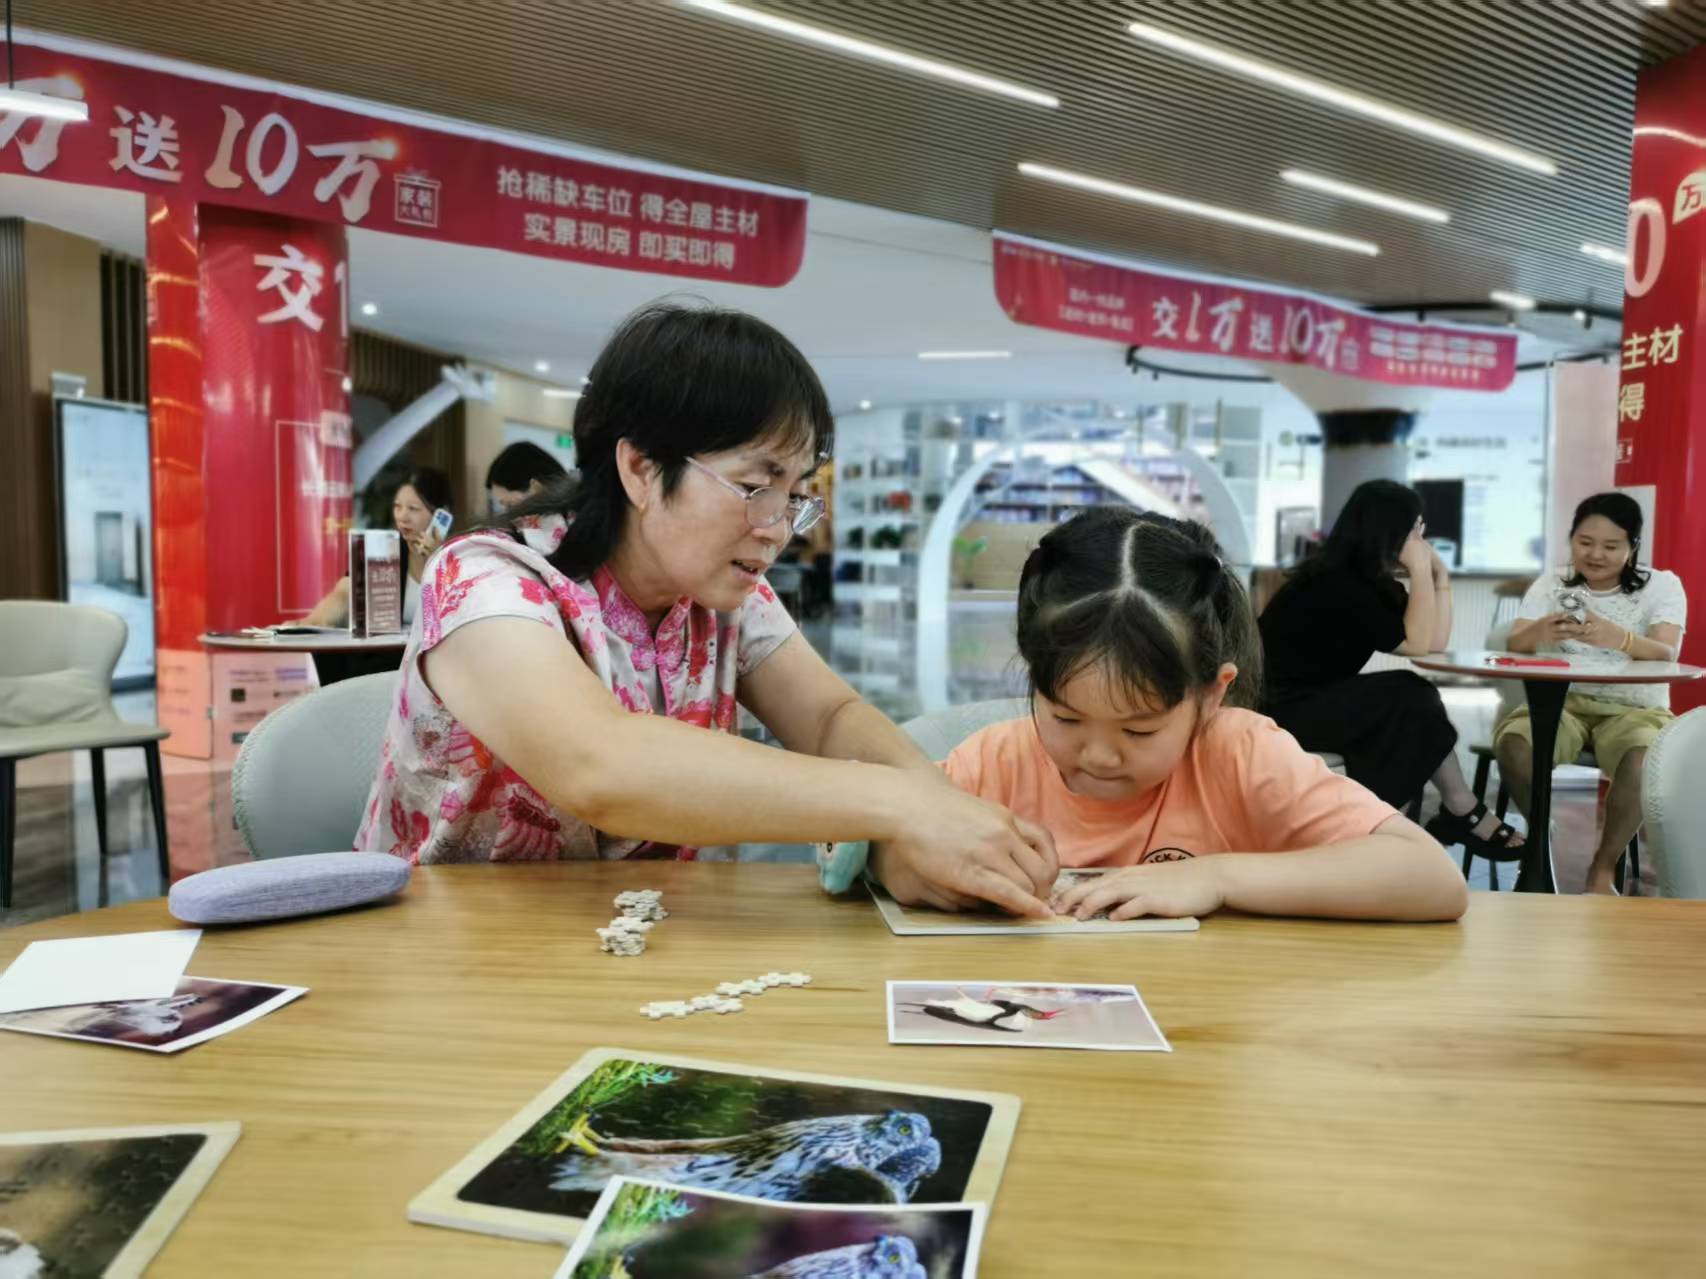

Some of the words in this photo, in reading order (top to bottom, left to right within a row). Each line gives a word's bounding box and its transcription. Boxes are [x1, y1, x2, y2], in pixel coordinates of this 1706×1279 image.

[497, 166, 632, 218] 抢稀缺车位
[639, 193, 759, 238] 得全屋主材
[523, 213, 631, 257] 实景现房
[639, 231, 736, 271] 即买即得
[1621, 323, 1684, 370] 主材
[1619, 382, 1645, 422] 得
